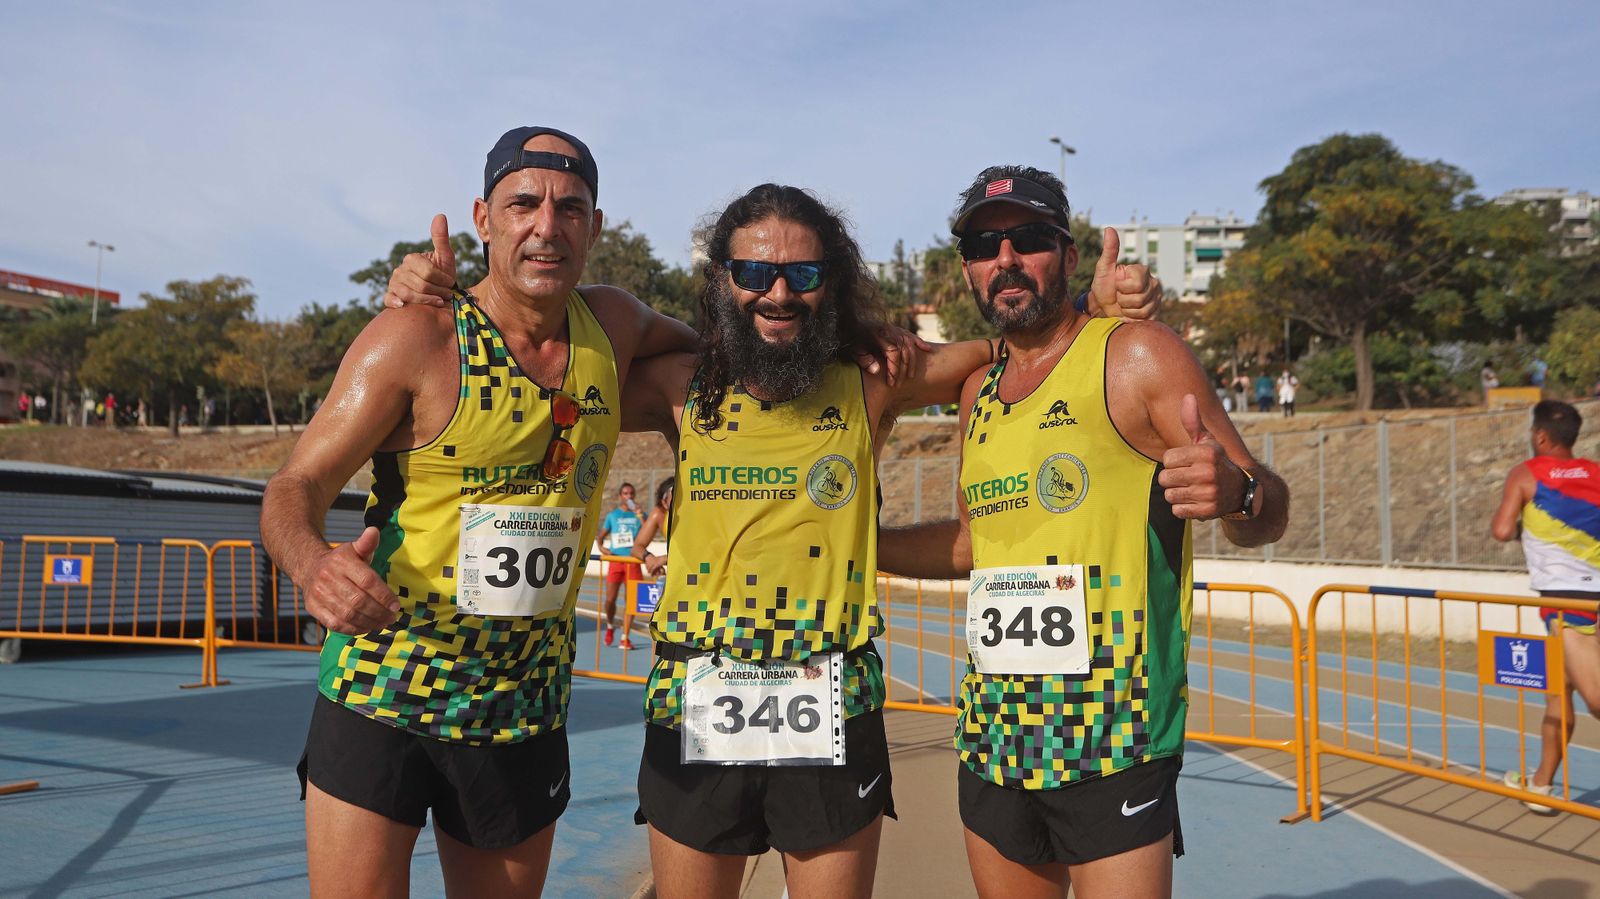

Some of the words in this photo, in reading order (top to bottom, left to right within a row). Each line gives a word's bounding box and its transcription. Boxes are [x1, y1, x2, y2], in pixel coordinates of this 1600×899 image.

[690, 466, 798, 486] RUTEROS
[962, 472, 1029, 505] UTEROS
[690, 489, 796, 501] INDEPENDIENTES
[509, 512, 526, 521] XXI
[528, 511, 561, 521] EDICIÓN
[494, 520, 538, 530] CARRERA
[539, 521, 568, 530] URBANA
[485, 546, 573, 589] 308
[993, 573, 1005, 581] XXI
[1006, 571, 1038, 581] EDICIÓN
[985, 581, 1017, 591] CARRERA
[1017, 580, 1050, 590] URBANA
[1015, 589, 1045, 597] ALGECIRAS
[980, 606, 1075, 648] 348
[732, 662, 746, 671] XXI
[718, 670, 760, 680] CARRERA
[761, 670, 799, 680] URBANA
[759, 679, 792, 687] ALGECIRAS
[712, 694, 821, 735] 346
